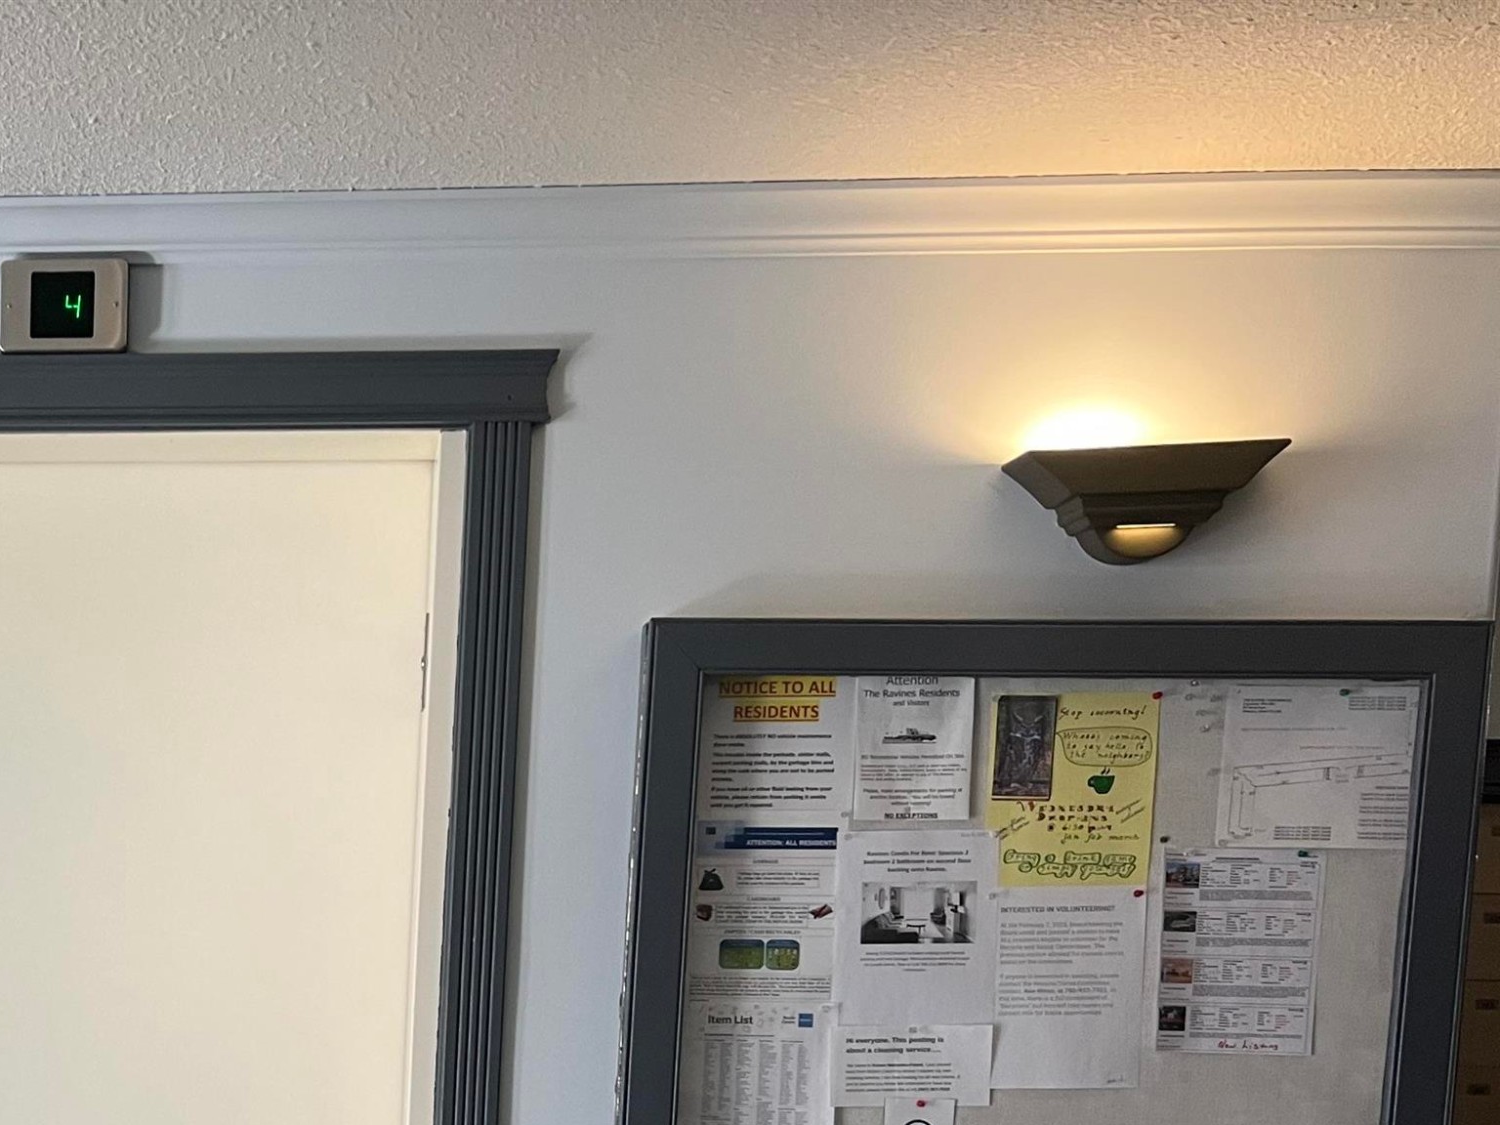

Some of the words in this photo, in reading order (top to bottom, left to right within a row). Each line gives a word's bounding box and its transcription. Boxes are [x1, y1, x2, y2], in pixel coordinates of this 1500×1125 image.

[65, 294, 82, 319] 4
[719, 680, 777, 693] NOTICE
[782, 680, 804, 693] TO
[809, 680, 836, 693] ALL
[886, 676, 939, 686] Attention
[864, 689, 880, 698] The
[733, 705, 820, 718] RESIDENTS
[707, 1015, 732, 1025] Item
[733, 1015, 754, 1025] List
